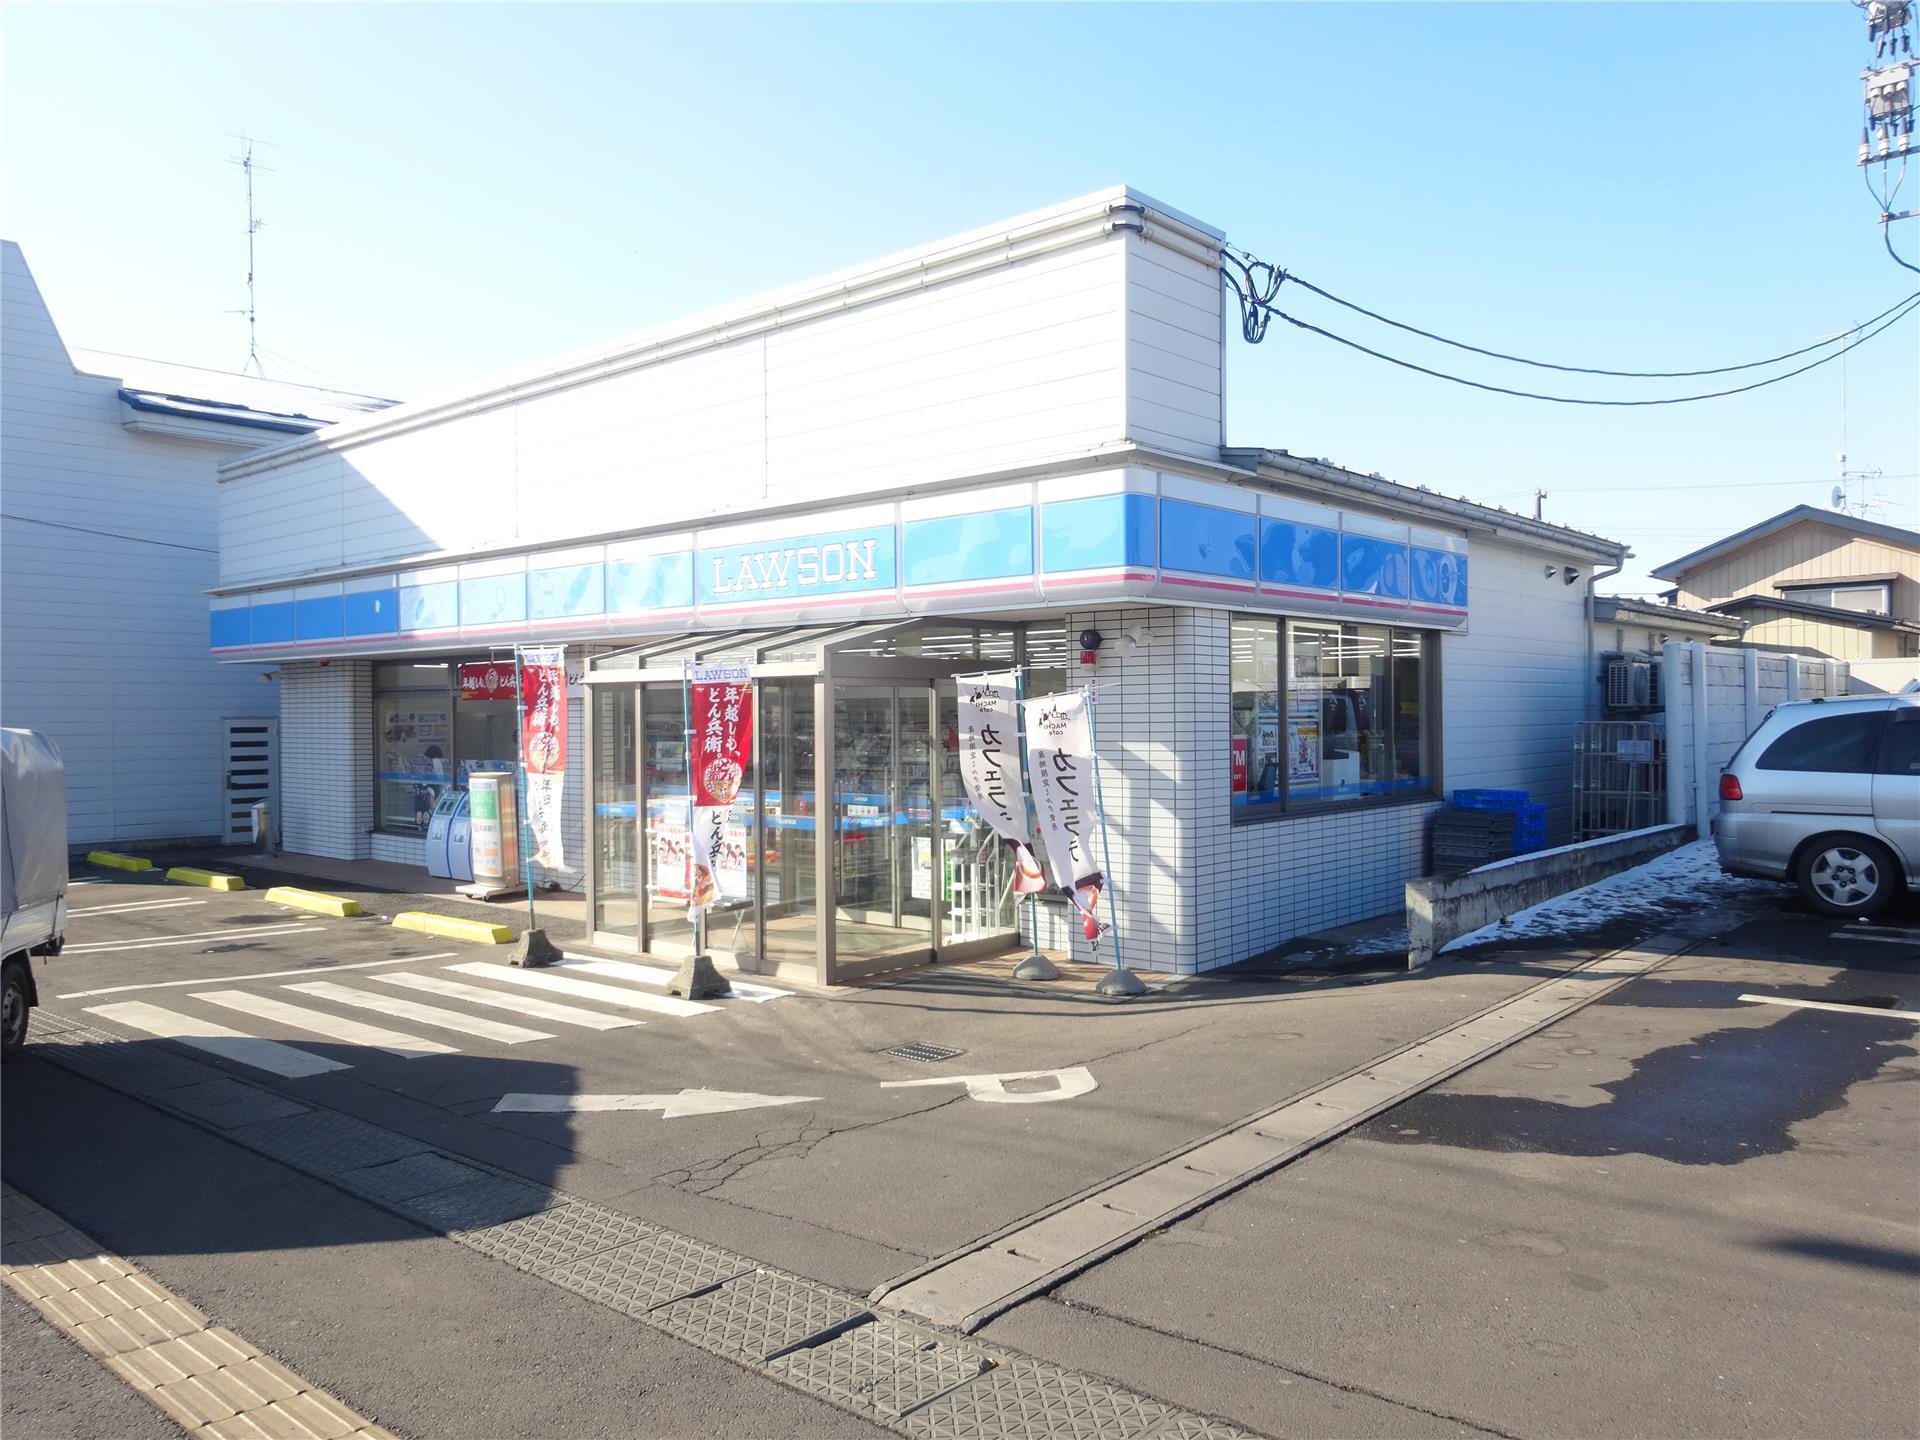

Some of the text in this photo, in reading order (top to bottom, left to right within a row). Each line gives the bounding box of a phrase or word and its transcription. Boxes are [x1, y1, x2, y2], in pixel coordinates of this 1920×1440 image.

[712, 538, 877, 593] LAWSON
[694, 668, 748, 681] LAWSON
[704, 687, 724, 759] どん兵衛。
[723, 686, 741, 758] 年越しも、
